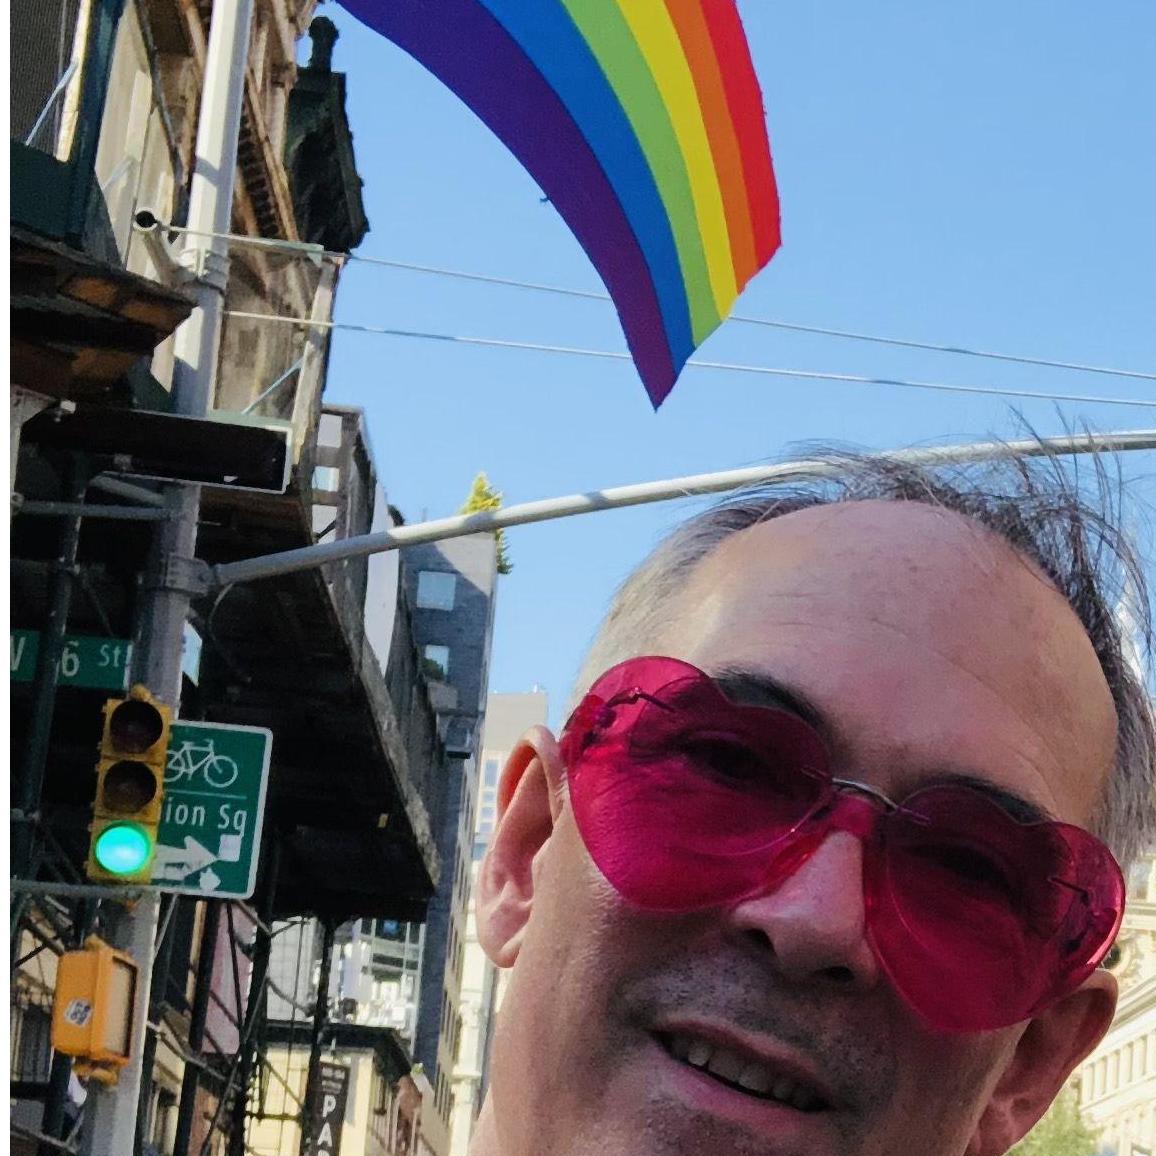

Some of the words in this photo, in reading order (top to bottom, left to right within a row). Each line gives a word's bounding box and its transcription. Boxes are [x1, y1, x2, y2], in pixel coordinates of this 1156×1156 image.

[60, 640, 80, 678] 6
[98, 644, 121, 668] St
[164, 796, 206, 827] ion
[217, 803, 248, 839] Sq
